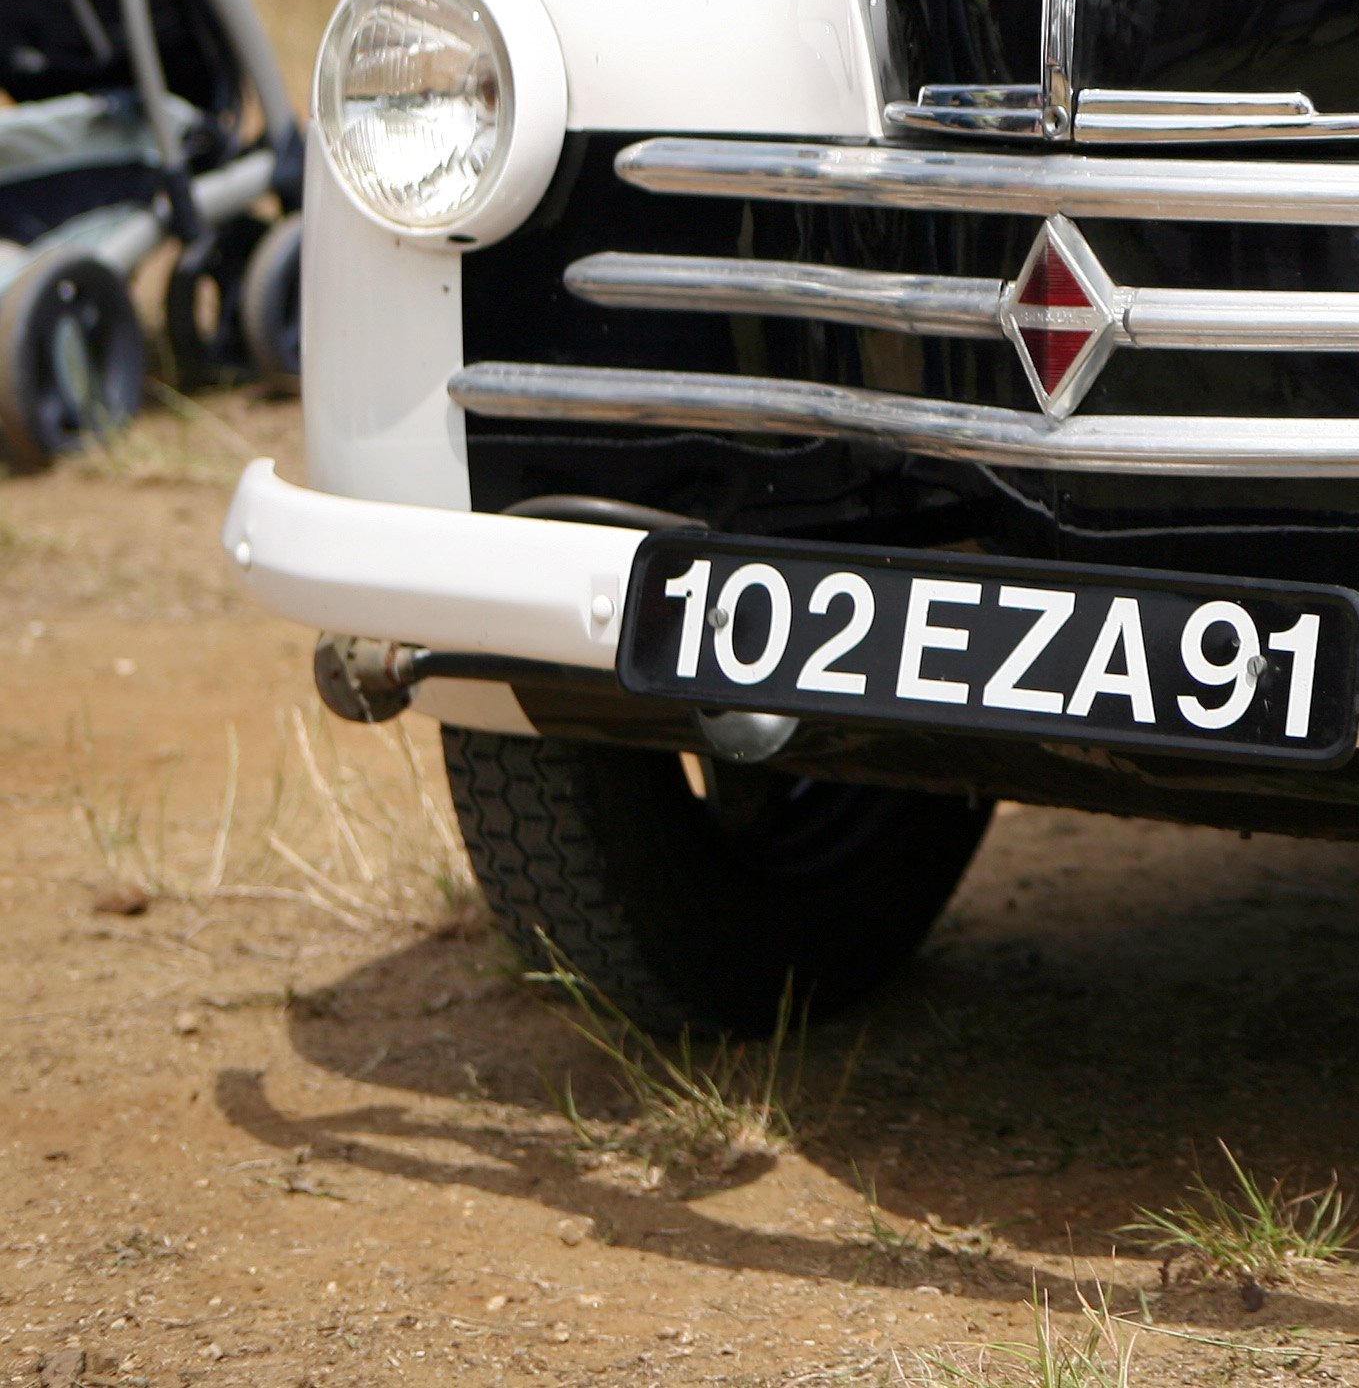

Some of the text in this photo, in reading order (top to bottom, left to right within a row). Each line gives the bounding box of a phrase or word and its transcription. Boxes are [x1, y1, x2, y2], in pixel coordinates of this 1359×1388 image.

[664, 559, 1321, 738] 102 EZA 91
